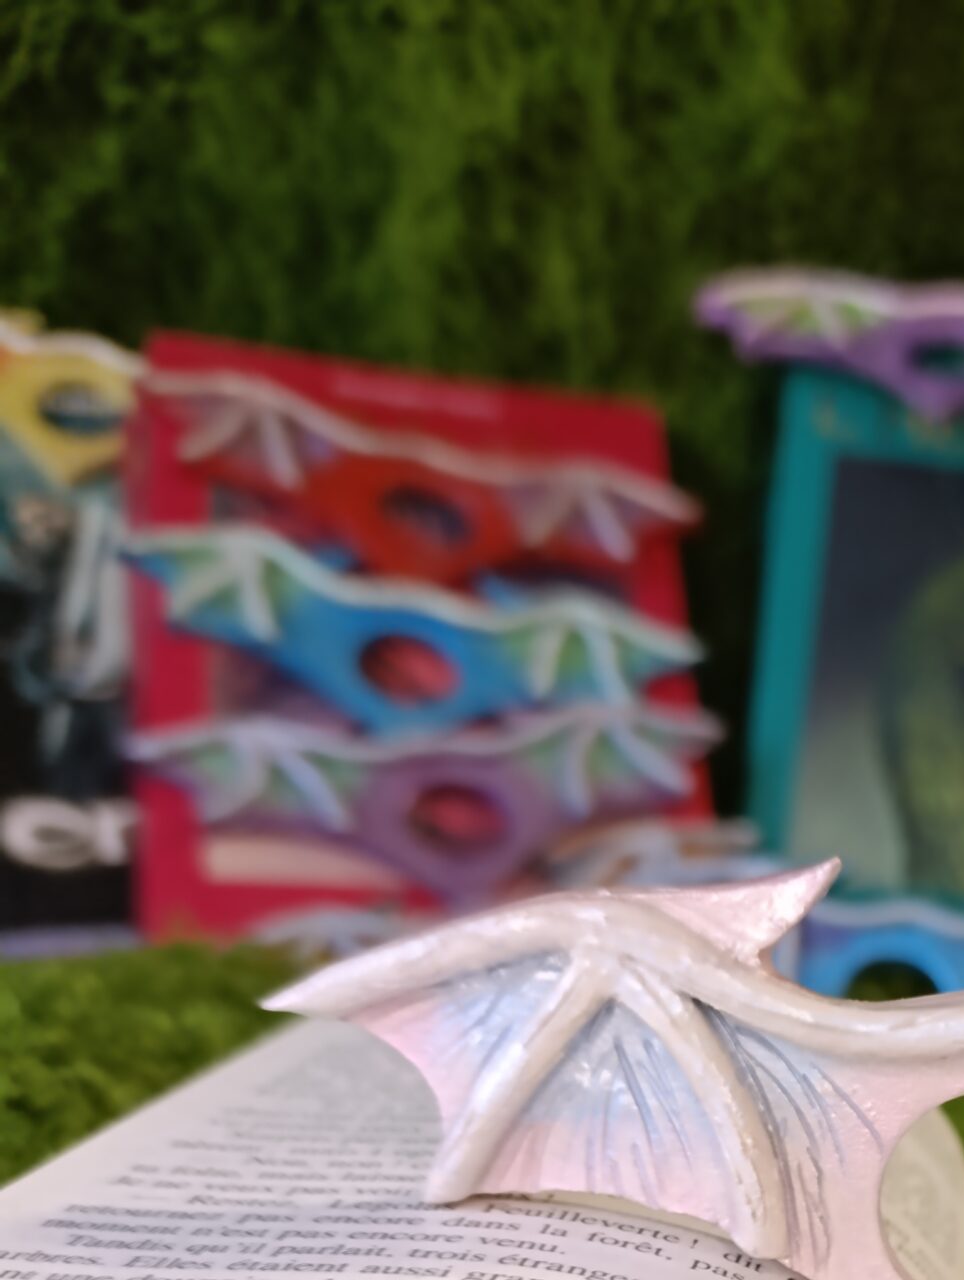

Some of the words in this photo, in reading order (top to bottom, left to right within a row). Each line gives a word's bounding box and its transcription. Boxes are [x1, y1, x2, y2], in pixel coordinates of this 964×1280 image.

[41, 1218, 183, 1236] moment
[276, 1230, 337, 1241] pas
[346, 1230, 466, 1244] encore
[478, 1235, 567, 1255] venu.
[236, 1213, 297, 1225] pas
[312, 1215, 427, 1226] encore
[440, 1216, 522, 1232] dans
[538, 1223, 569, 1238] la
[484, 1203, 681, 1244] Feuilleverte
[723, 1252, 762, 1272] dit
[65, 1233, 175, 1251] Tandis
[408, 1250, 489, 1263] trois
[121, 1255, 214, 1270] Elles
[225, 1258, 350, 1273] étaient
[358, 1263, 454, 1278] aussi
